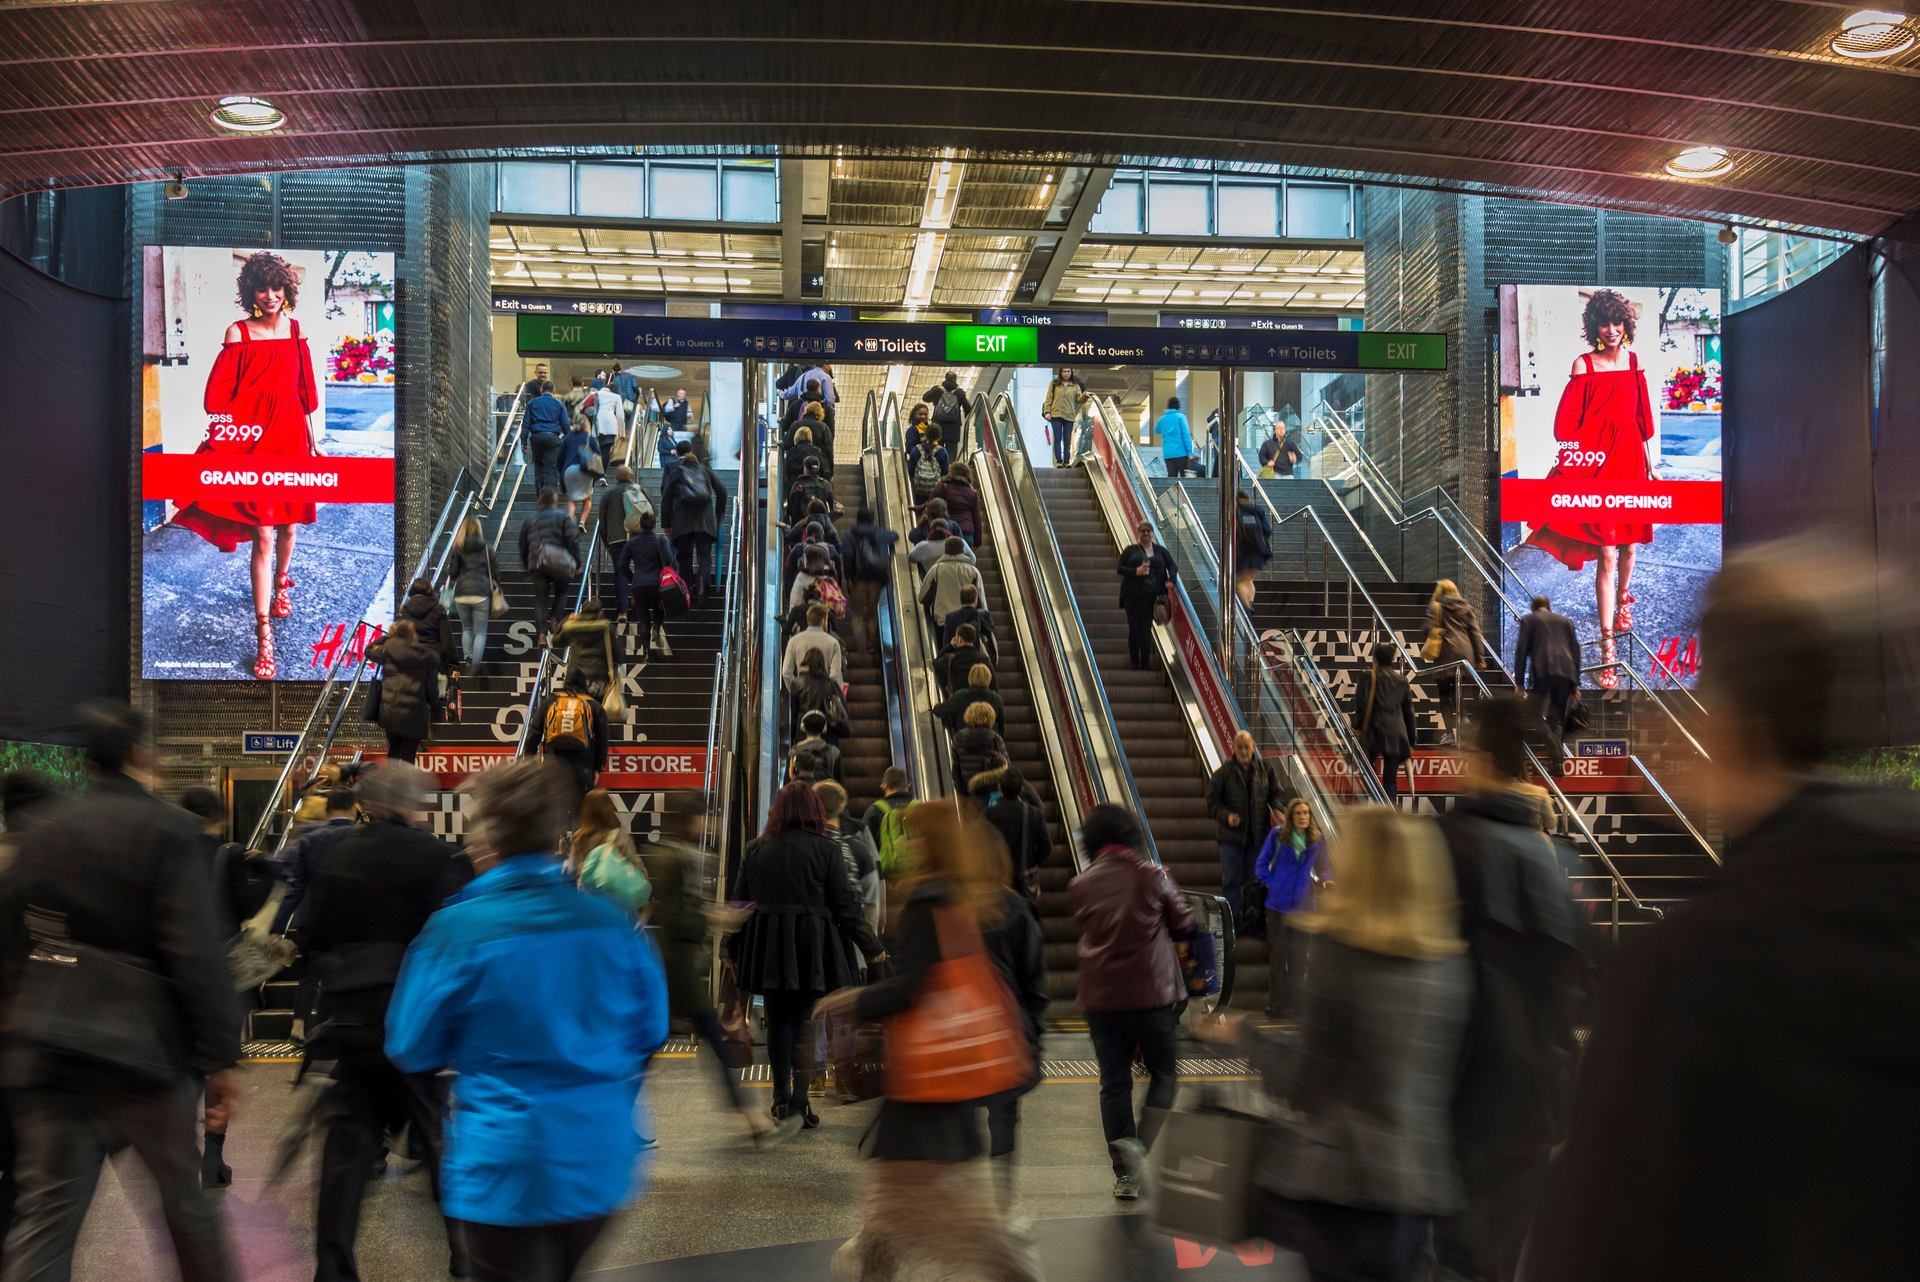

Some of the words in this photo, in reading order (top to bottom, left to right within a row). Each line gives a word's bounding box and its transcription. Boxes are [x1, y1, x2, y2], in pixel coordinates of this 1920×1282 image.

[501, 299, 520, 309] Exit
[1021, 315, 1051, 325] Toilets
[1256, 320, 1273, 329] Exit
[550, 326, 583, 342] EXIT
[645, 334, 672, 346] Exit
[676, 339, 685, 347] to
[687, 339, 714, 348] Queen
[716, 339, 724, 348] St
[879, 338, 927, 353] Toilets
[976, 335, 1007, 352] EXIT
[1068, 342, 1094, 356] Exit
[1098, 348, 1106, 356] to
[1108, 348, 1134, 357] Queen
[1291, 346, 1337, 360] Toilets
[1387, 343, 1417, 359] EXIT
[207, 413, 233, 423] ress
[214, 424, 263, 441] 29.99
[1557, 440, 1580, 450] ress
[1563, 450, 1606, 467] 29.99
[200, 470, 259, 485] GRAND
[261, 471, 338, 487] OPENING!
[1551, 494, 1602, 508] GRAND
[1604, 495, 1673, 509] OPENING!
[153, 660, 181, 668] Available
[182, 660, 199, 668] while
[276, 739, 294, 749] Lift
[1605, 746, 1621, 756] Lift
[625, 755, 697, 773] STORE.
